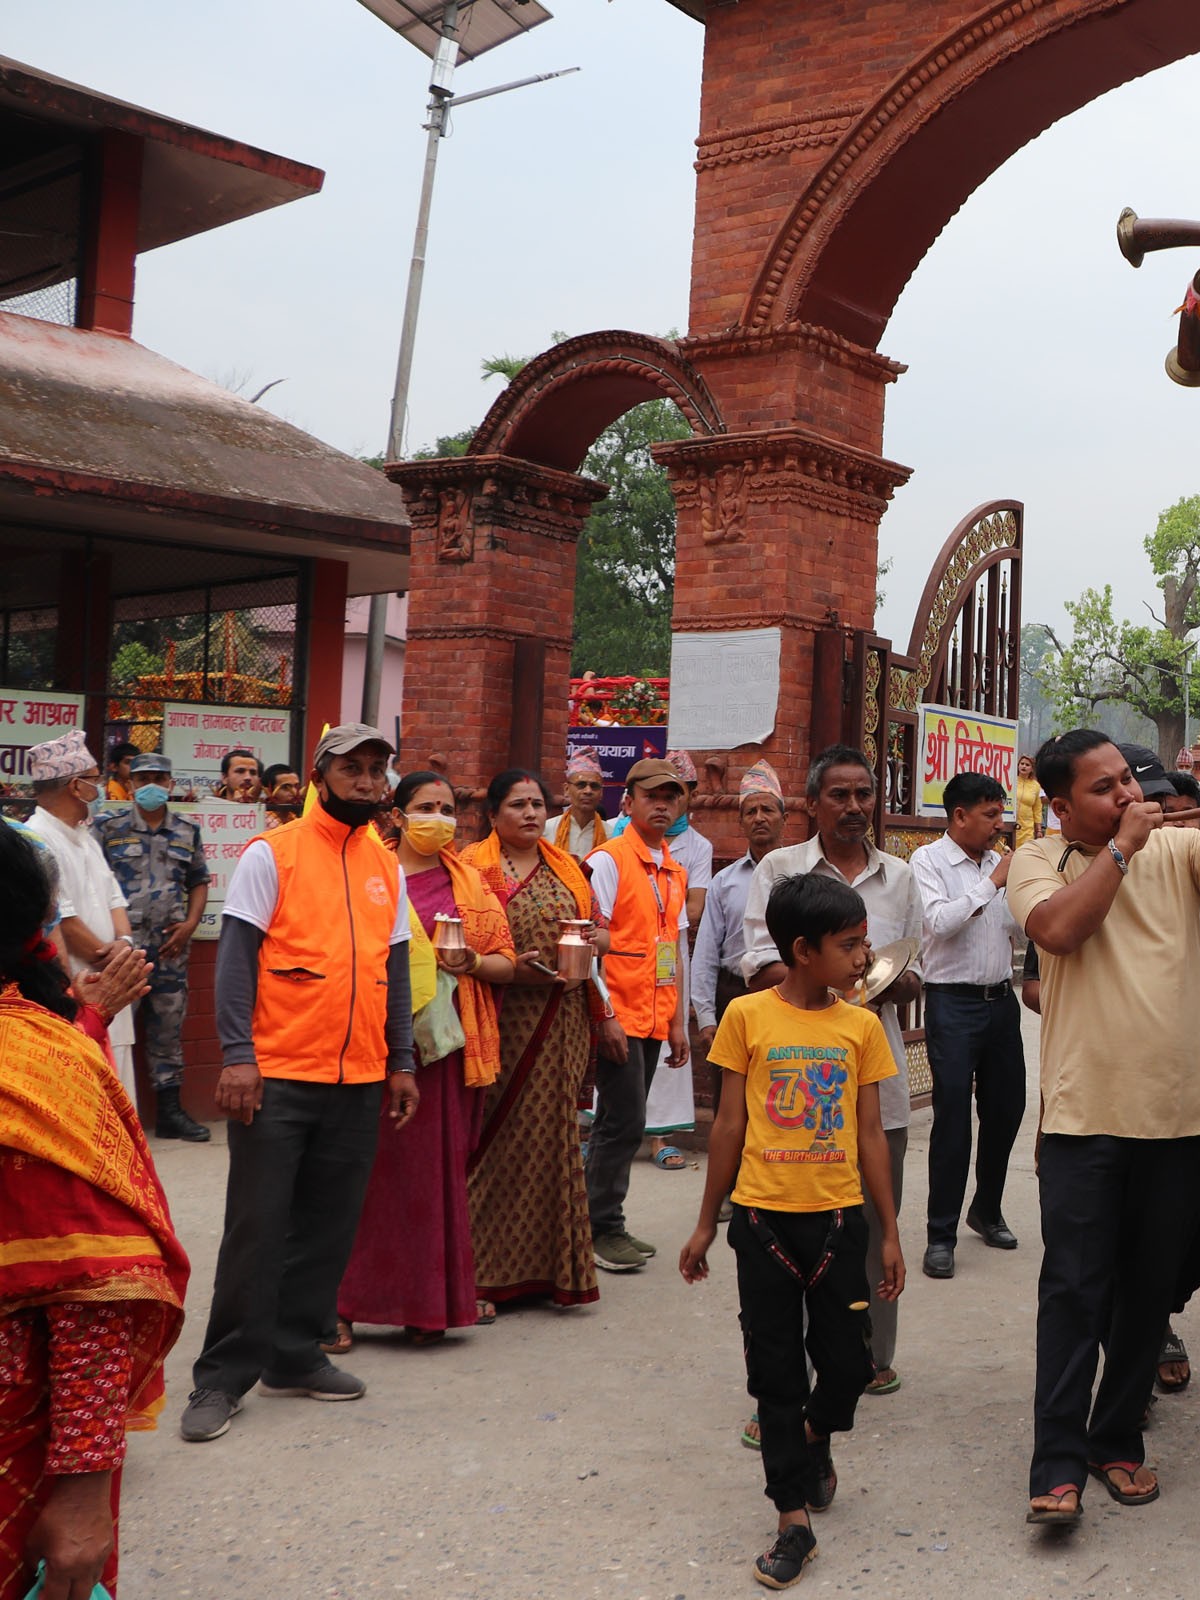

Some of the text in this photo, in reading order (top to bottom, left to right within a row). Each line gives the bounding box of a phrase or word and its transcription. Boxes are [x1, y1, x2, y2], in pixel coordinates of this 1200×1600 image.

[22, 701, 80, 726] आश्रम
[925, 718, 950, 783] श्री
[767, 1046, 848, 1062] ANTHONY
[770, 1069, 802, 1111] 7
[765, 1151, 845, 1161] THE BIRTHDAY BOY
